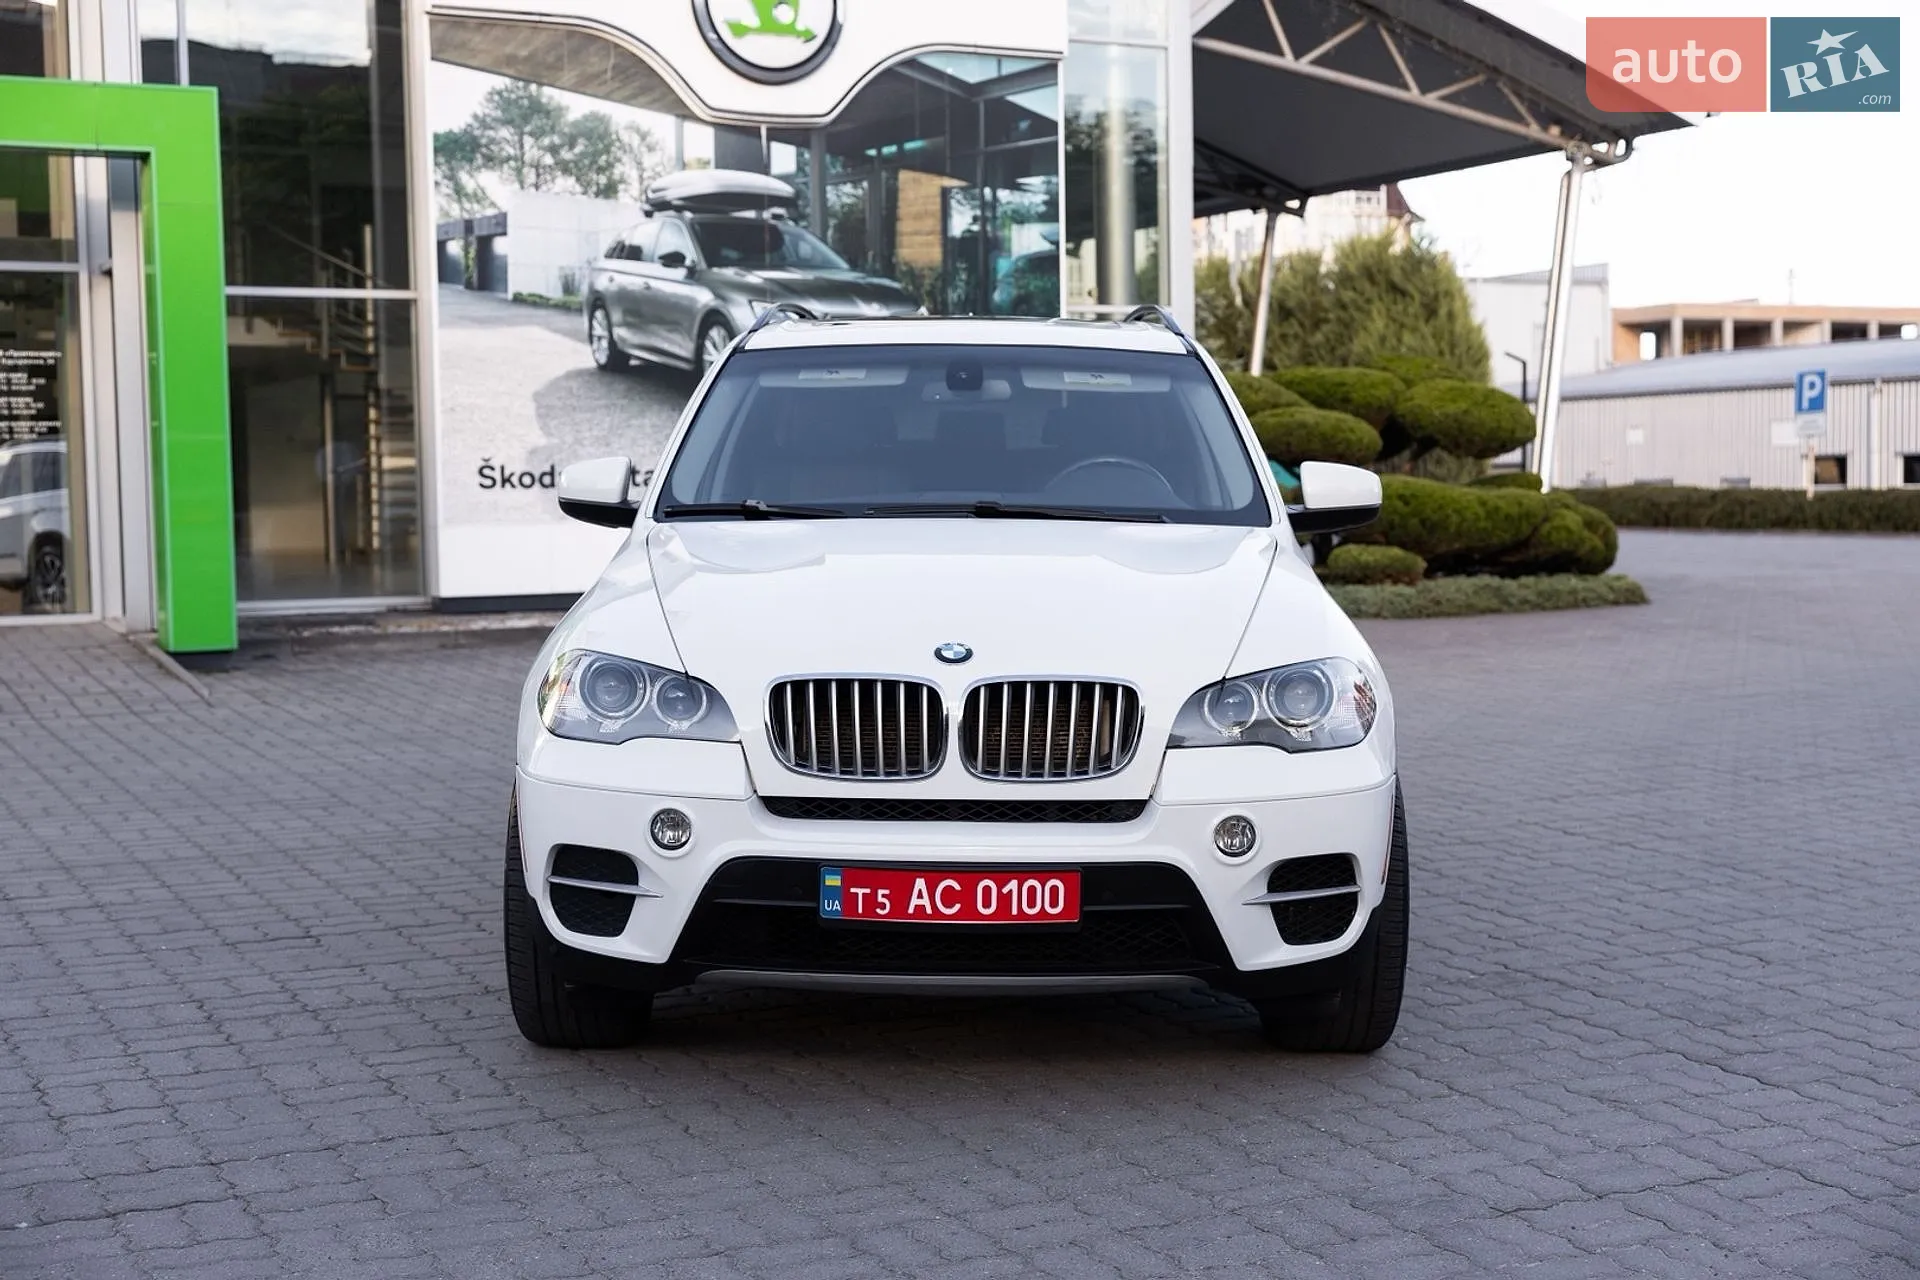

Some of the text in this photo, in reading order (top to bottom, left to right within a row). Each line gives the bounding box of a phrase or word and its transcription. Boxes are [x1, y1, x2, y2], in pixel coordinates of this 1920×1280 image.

[1802, 374, 1822, 410] P
[478, 457, 561, 489] Škod
[824, 899, 841, 911] UA
[907, 878, 961, 915] AC
[976, 878, 1065, 915] 0100
